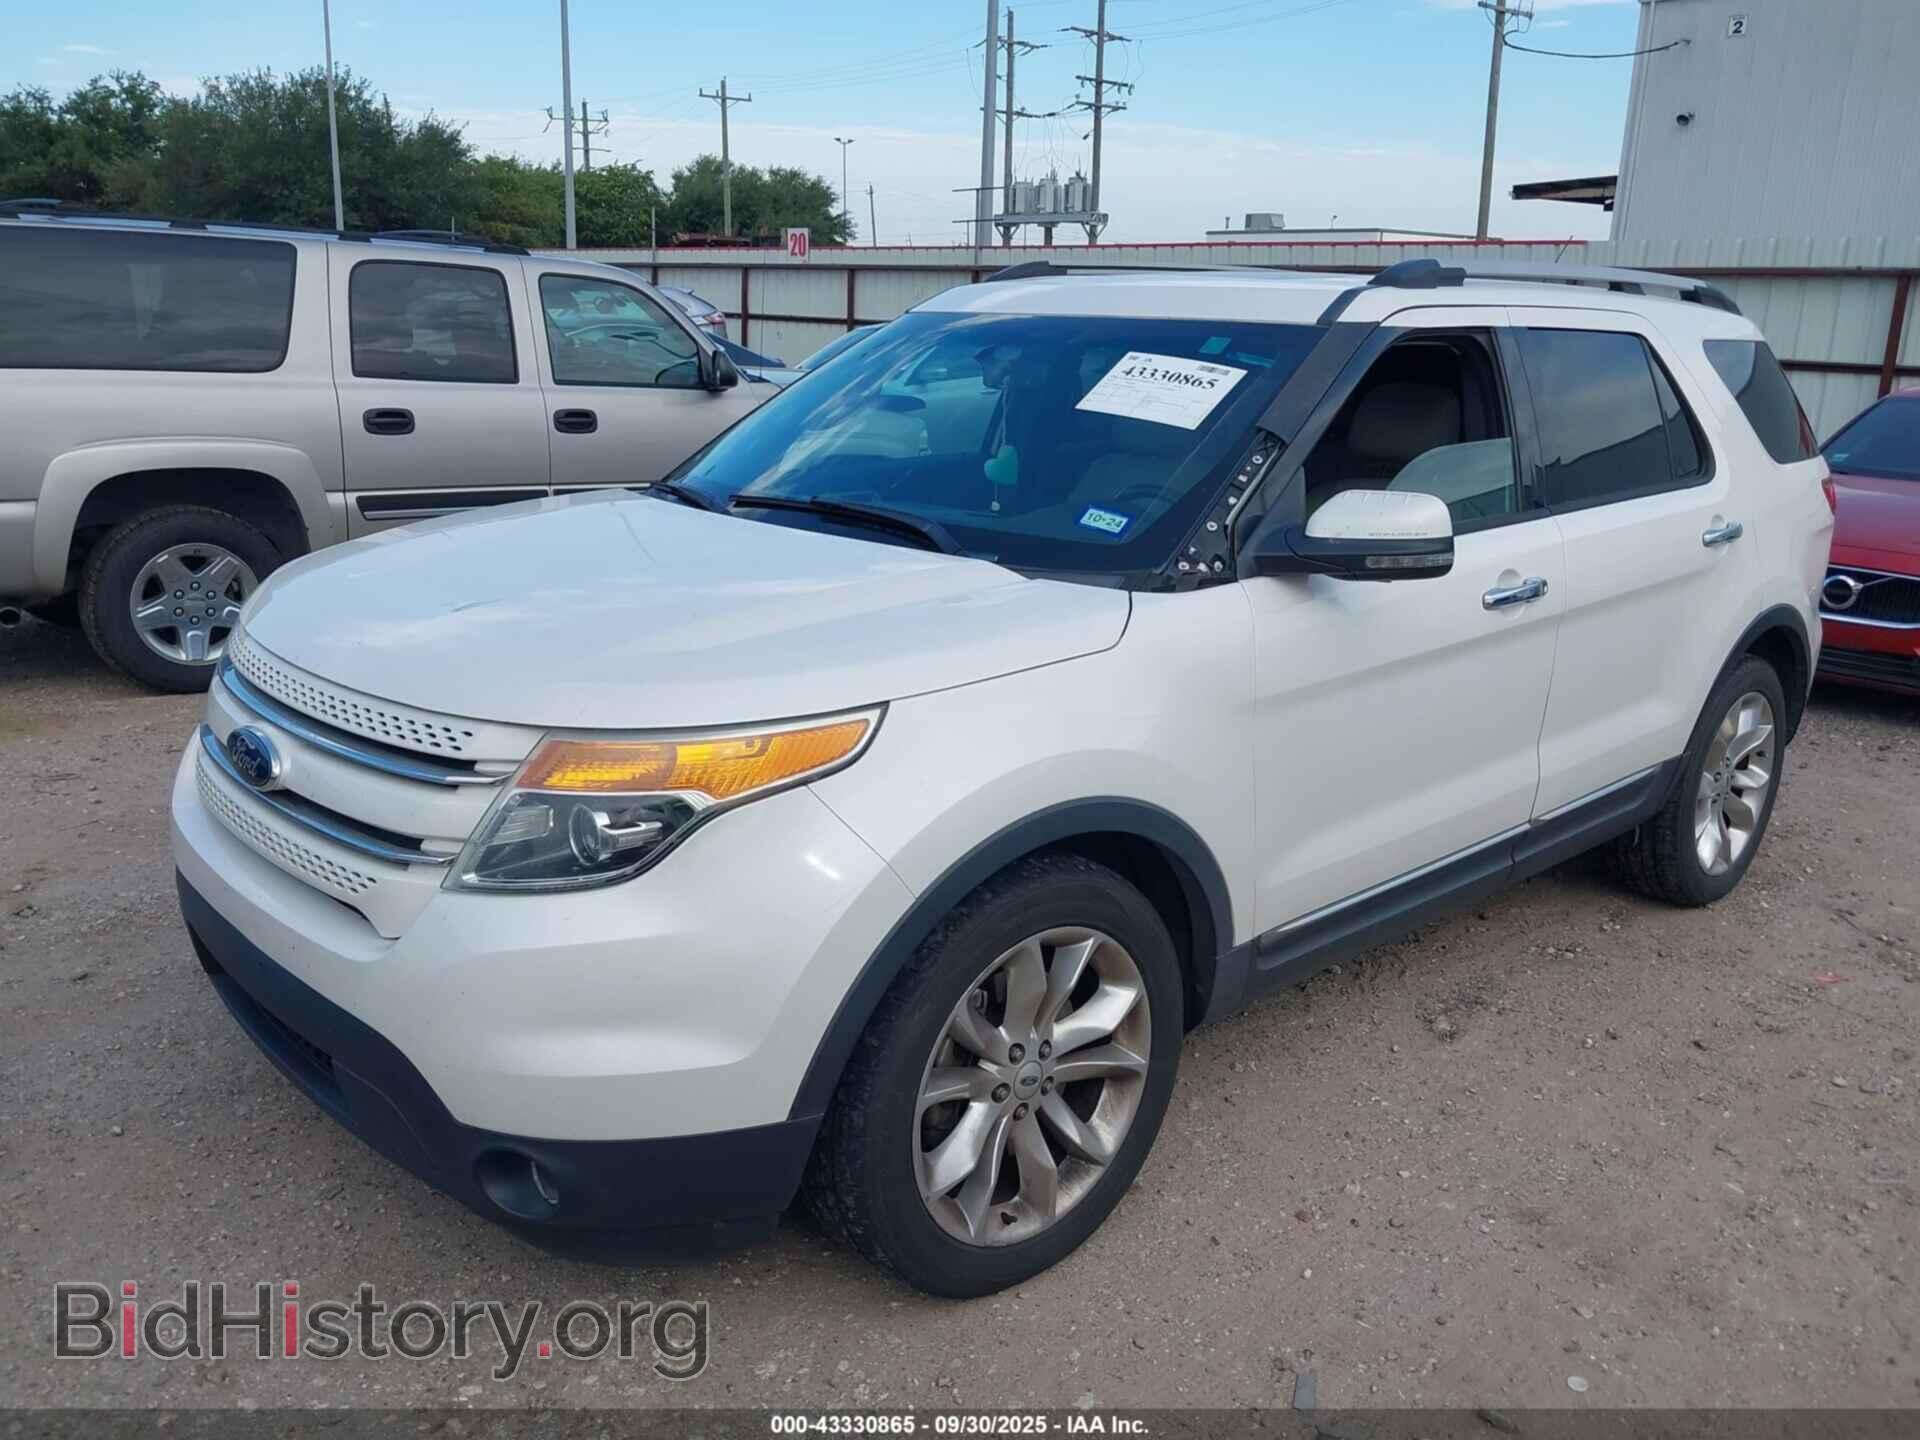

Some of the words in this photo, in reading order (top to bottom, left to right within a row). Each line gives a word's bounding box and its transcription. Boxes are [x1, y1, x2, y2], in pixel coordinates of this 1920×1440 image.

[1732, 20, 1744, 34] 2
[790, 232, 806, 257] 20
[1122, 366, 1219, 390] 43330865
[231, 735, 261, 777] Ford
